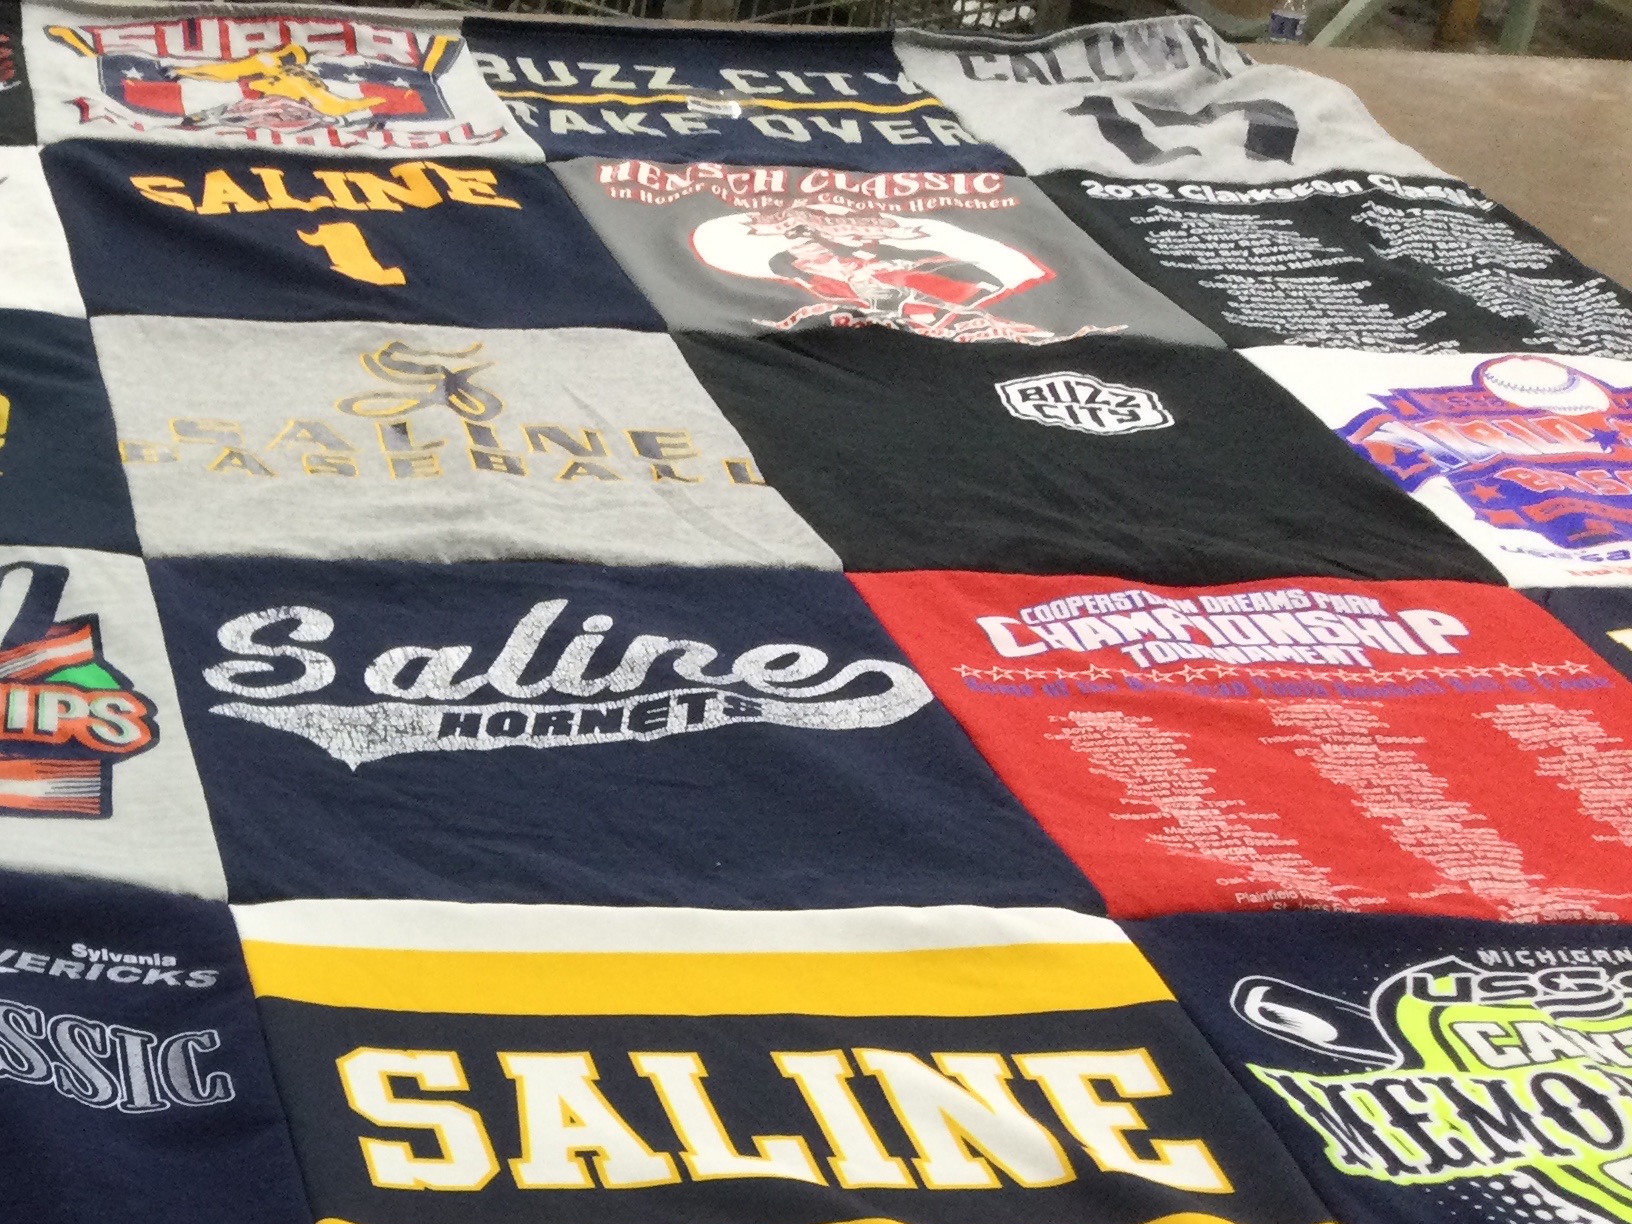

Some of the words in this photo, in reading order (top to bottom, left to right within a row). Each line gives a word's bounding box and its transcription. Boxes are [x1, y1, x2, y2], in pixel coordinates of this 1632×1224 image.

[81, 17, 420, 66] SUPER
[469, 51, 693, 89] BUZZ
[718, 68, 925, 96] CITY
[503, 99, 722, 138] TAKE
[746, 114, 980, 146] OVER
[129, 160, 522, 215] SALINE
[596, 160, 786, 194] HENSCH
[798, 168, 1005, 199] CLASSIC
[1081, 179, 1175, 200] 2012
[1178, 179, 1364, 203] Clarkston
[1367, 174, 1494, 211] Classic
[732, 197, 785, 208] Mike
[296, 222, 407, 286] 1
[1018, 380, 1141, 409] BUZZ
[1032, 403, 1142, 428] CITY
[171, 418, 701, 461] SALINE
[119, 438, 769, 487] BASEBALL
[1018, 590, 1198, 625] COOPERSTOWN
[1197, 588, 1312, 613] DREAMS
[1310, 591, 1390, 618] PARK
[203, 599, 838, 700] Saline
[977, 607, 1469, 659] CHAMPIONSHIP
[1121, 640, 1374, 669] TOURNAMENT
[437, 690, 763, 741] HORNETS
[70, 941, 179, 969] Sylvania
[336, 1046, 1236, 1195] SALINE
